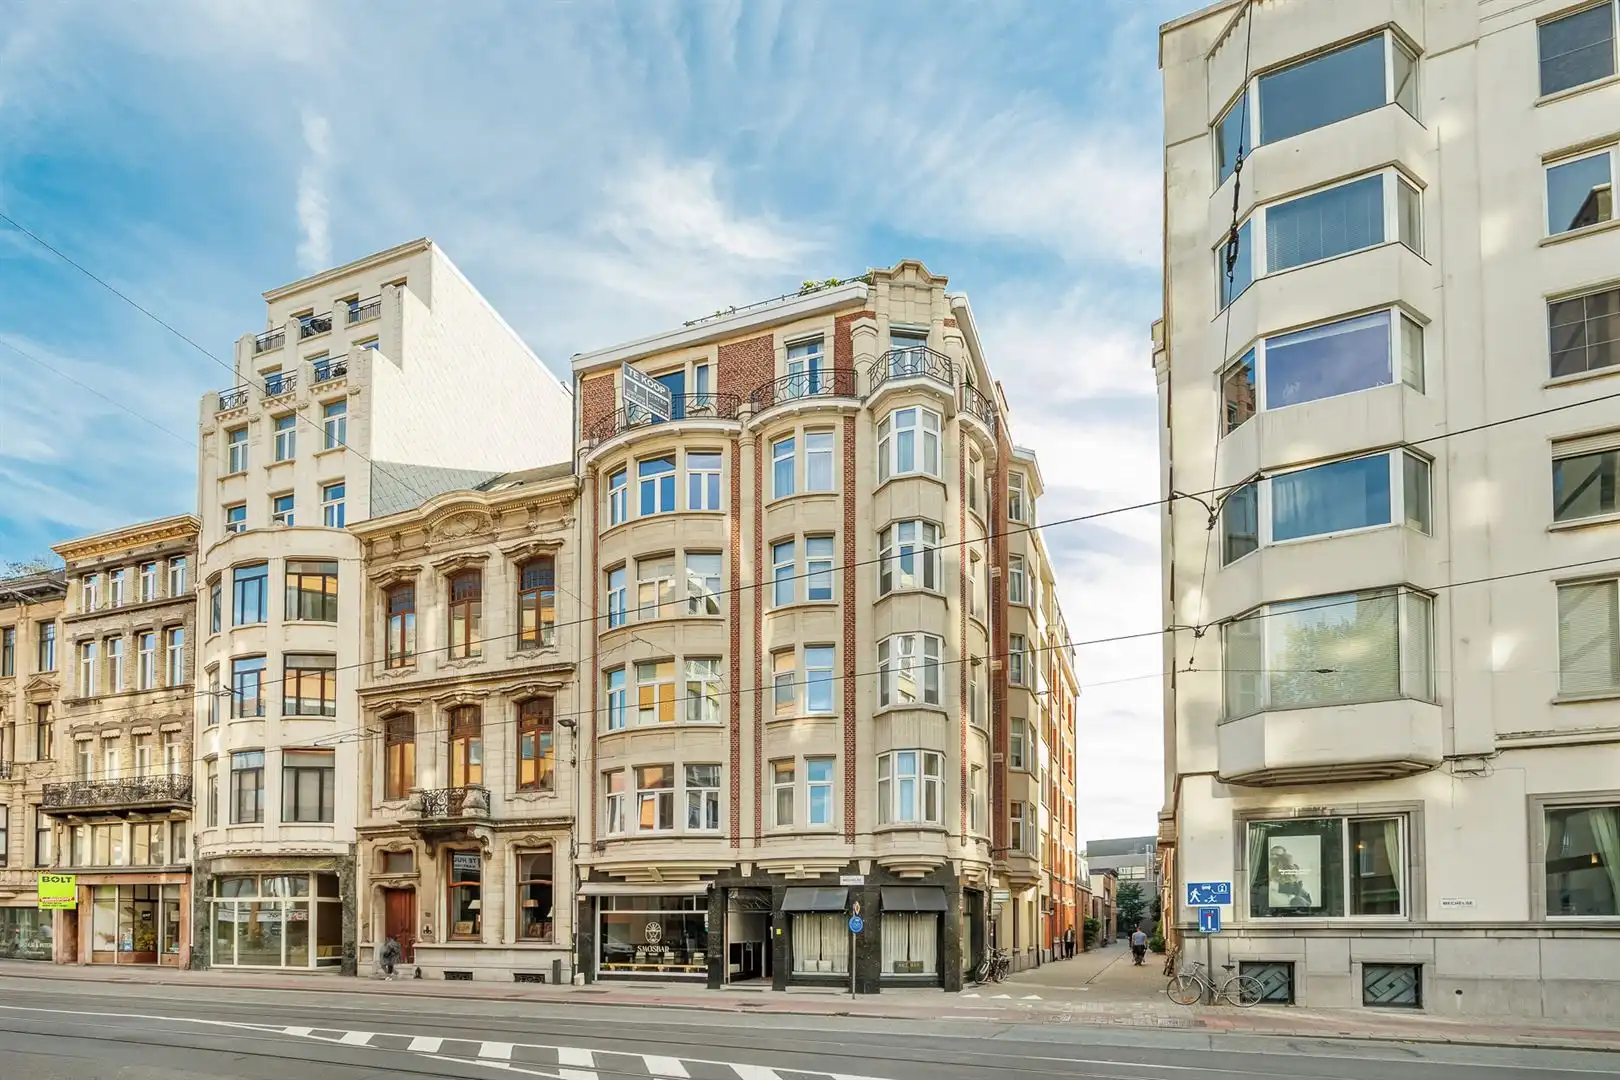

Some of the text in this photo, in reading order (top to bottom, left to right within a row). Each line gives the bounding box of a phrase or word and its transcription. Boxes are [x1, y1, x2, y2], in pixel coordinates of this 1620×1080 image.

[627, 367, 666, 394] TE KOOP
[637, 945, 670, 953] SMOSBAR
